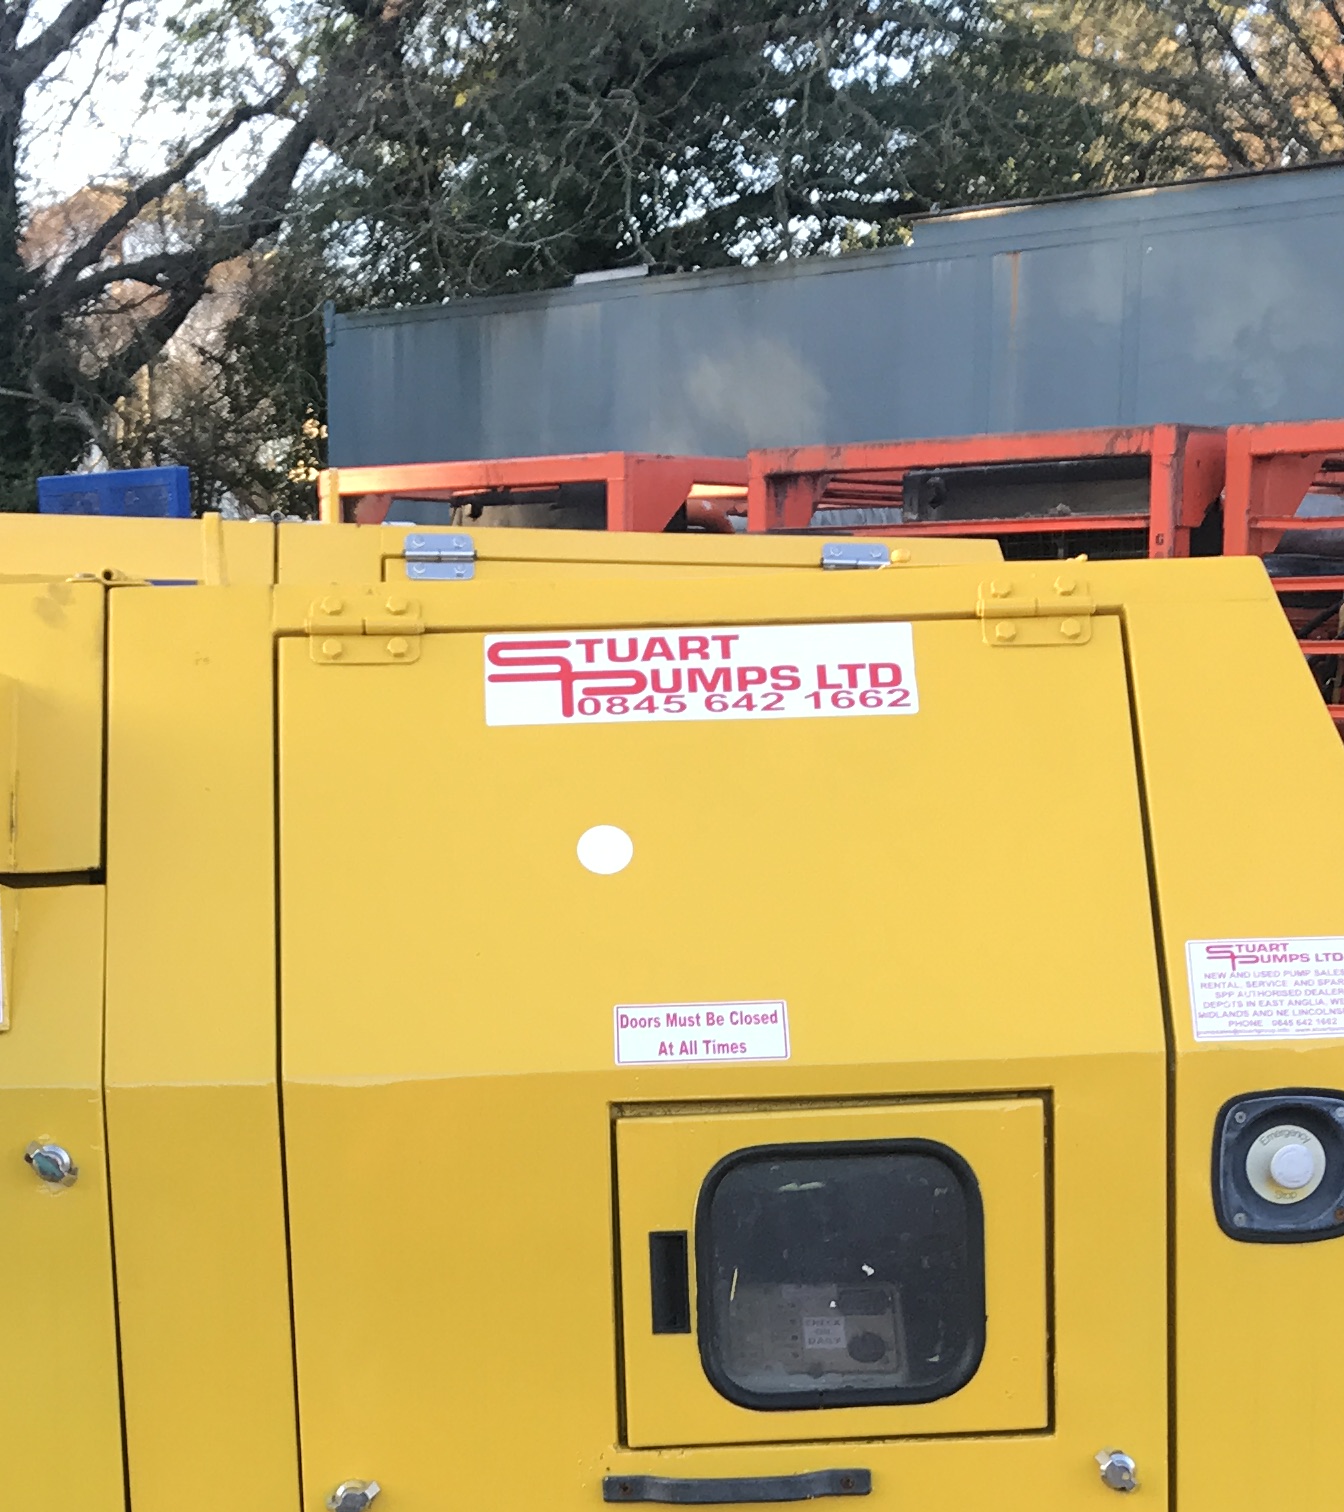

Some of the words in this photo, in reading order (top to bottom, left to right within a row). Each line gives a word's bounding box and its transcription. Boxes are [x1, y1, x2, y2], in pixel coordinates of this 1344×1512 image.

[487, 635, 739, 672] STUART
[488, 665, 801, 717] PUMPS
[816, 662, 903, 690] LTD
[577, 694, 688, 716] 0845
[704, 691, 786, 713] 642
[804, 688, 912, 710] 1662
[1205, 942, 1289, 956] STUART
[1206, 952, 1311, 971] PUMPS
[1315, 952, 1344, 963] LTD
[1229, 971, 1251, 979] AND
[1253, 970, 1281, 978] USED
[1283, 969, 1311, 977] PUMP
[1245, 979, 1288, 988] SERVICE
[1293, 979, 1315, 987] AND
[1237, 989, 1302, 998] AUTHORISED
[1304, 988, 1344, 996] DEALER
[1203, 1001, 1244, 1009] DEPOTS
[1258, 999, 1284, 1007] EAST
[619, 1014, 661, 1029] Doors
[666, 1012, 701, 1027] Must
[706, 1011, 725, 1026] Be
[729, 1009, 778, 1026] Closed
[1198, 1010, 1249, 1019] MIDLANDS
[1252, 1009, 1273, 1017] AND
[1276, 1009, 1289, 1017] NE
[658, 1041, 674, 1056] At
[679, 1039, 698, 1056] All
[702, 1039, 747, 1055] Times
[1259, 1129, 1311, 1146] Emergency
